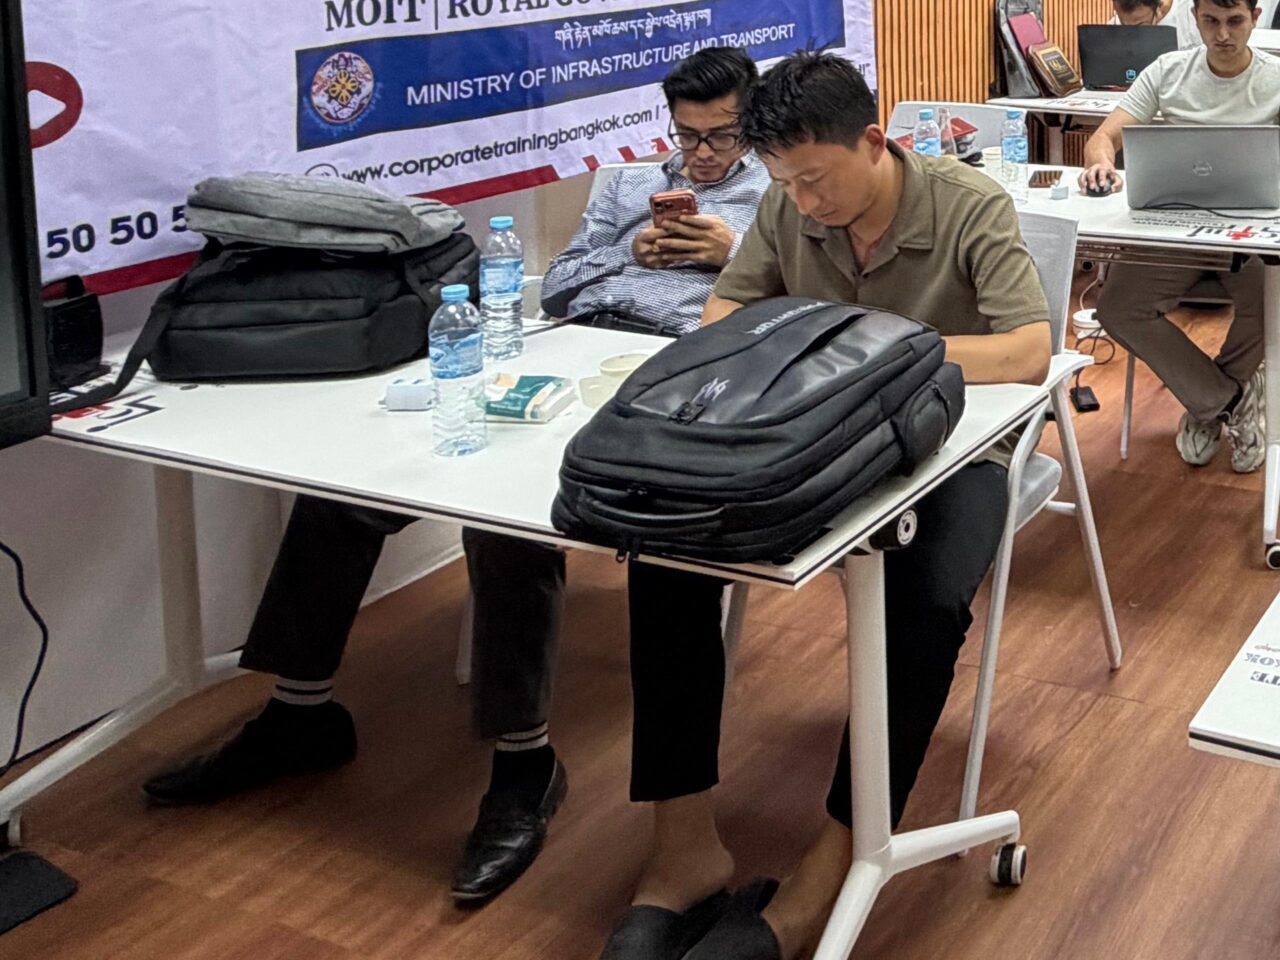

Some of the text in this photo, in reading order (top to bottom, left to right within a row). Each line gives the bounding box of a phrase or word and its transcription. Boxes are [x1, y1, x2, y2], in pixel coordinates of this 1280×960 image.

[407, 73, 515, 106] MINISTRY
[519, 68, 547, 89] OF
[552, 44, 690, 83] INFRASTRUCTURE
[721, 23, 796, 48] TRANSPORT
[45, 223, 96, 259] 50
[110, 212, 158, 245] 50
